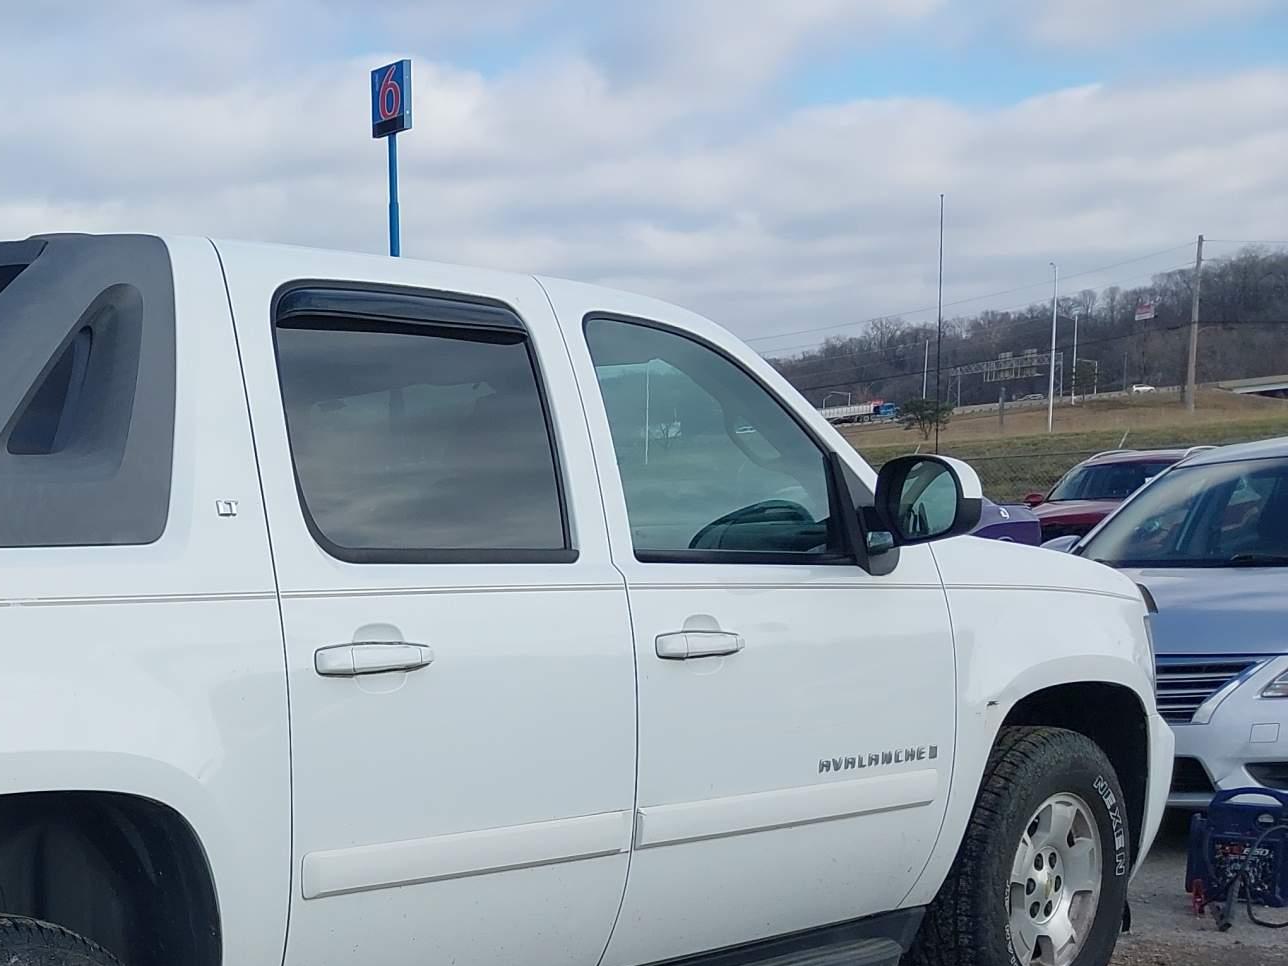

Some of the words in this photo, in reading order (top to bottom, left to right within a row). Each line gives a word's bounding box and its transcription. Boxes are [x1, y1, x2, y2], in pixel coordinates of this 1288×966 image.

[379, 65, 401, 121] 6
[215, 500, 239, 517] LT
[818, 746, 926, 774] AVALANCHE
[1093, 775, 1126, 876] NEXEN
